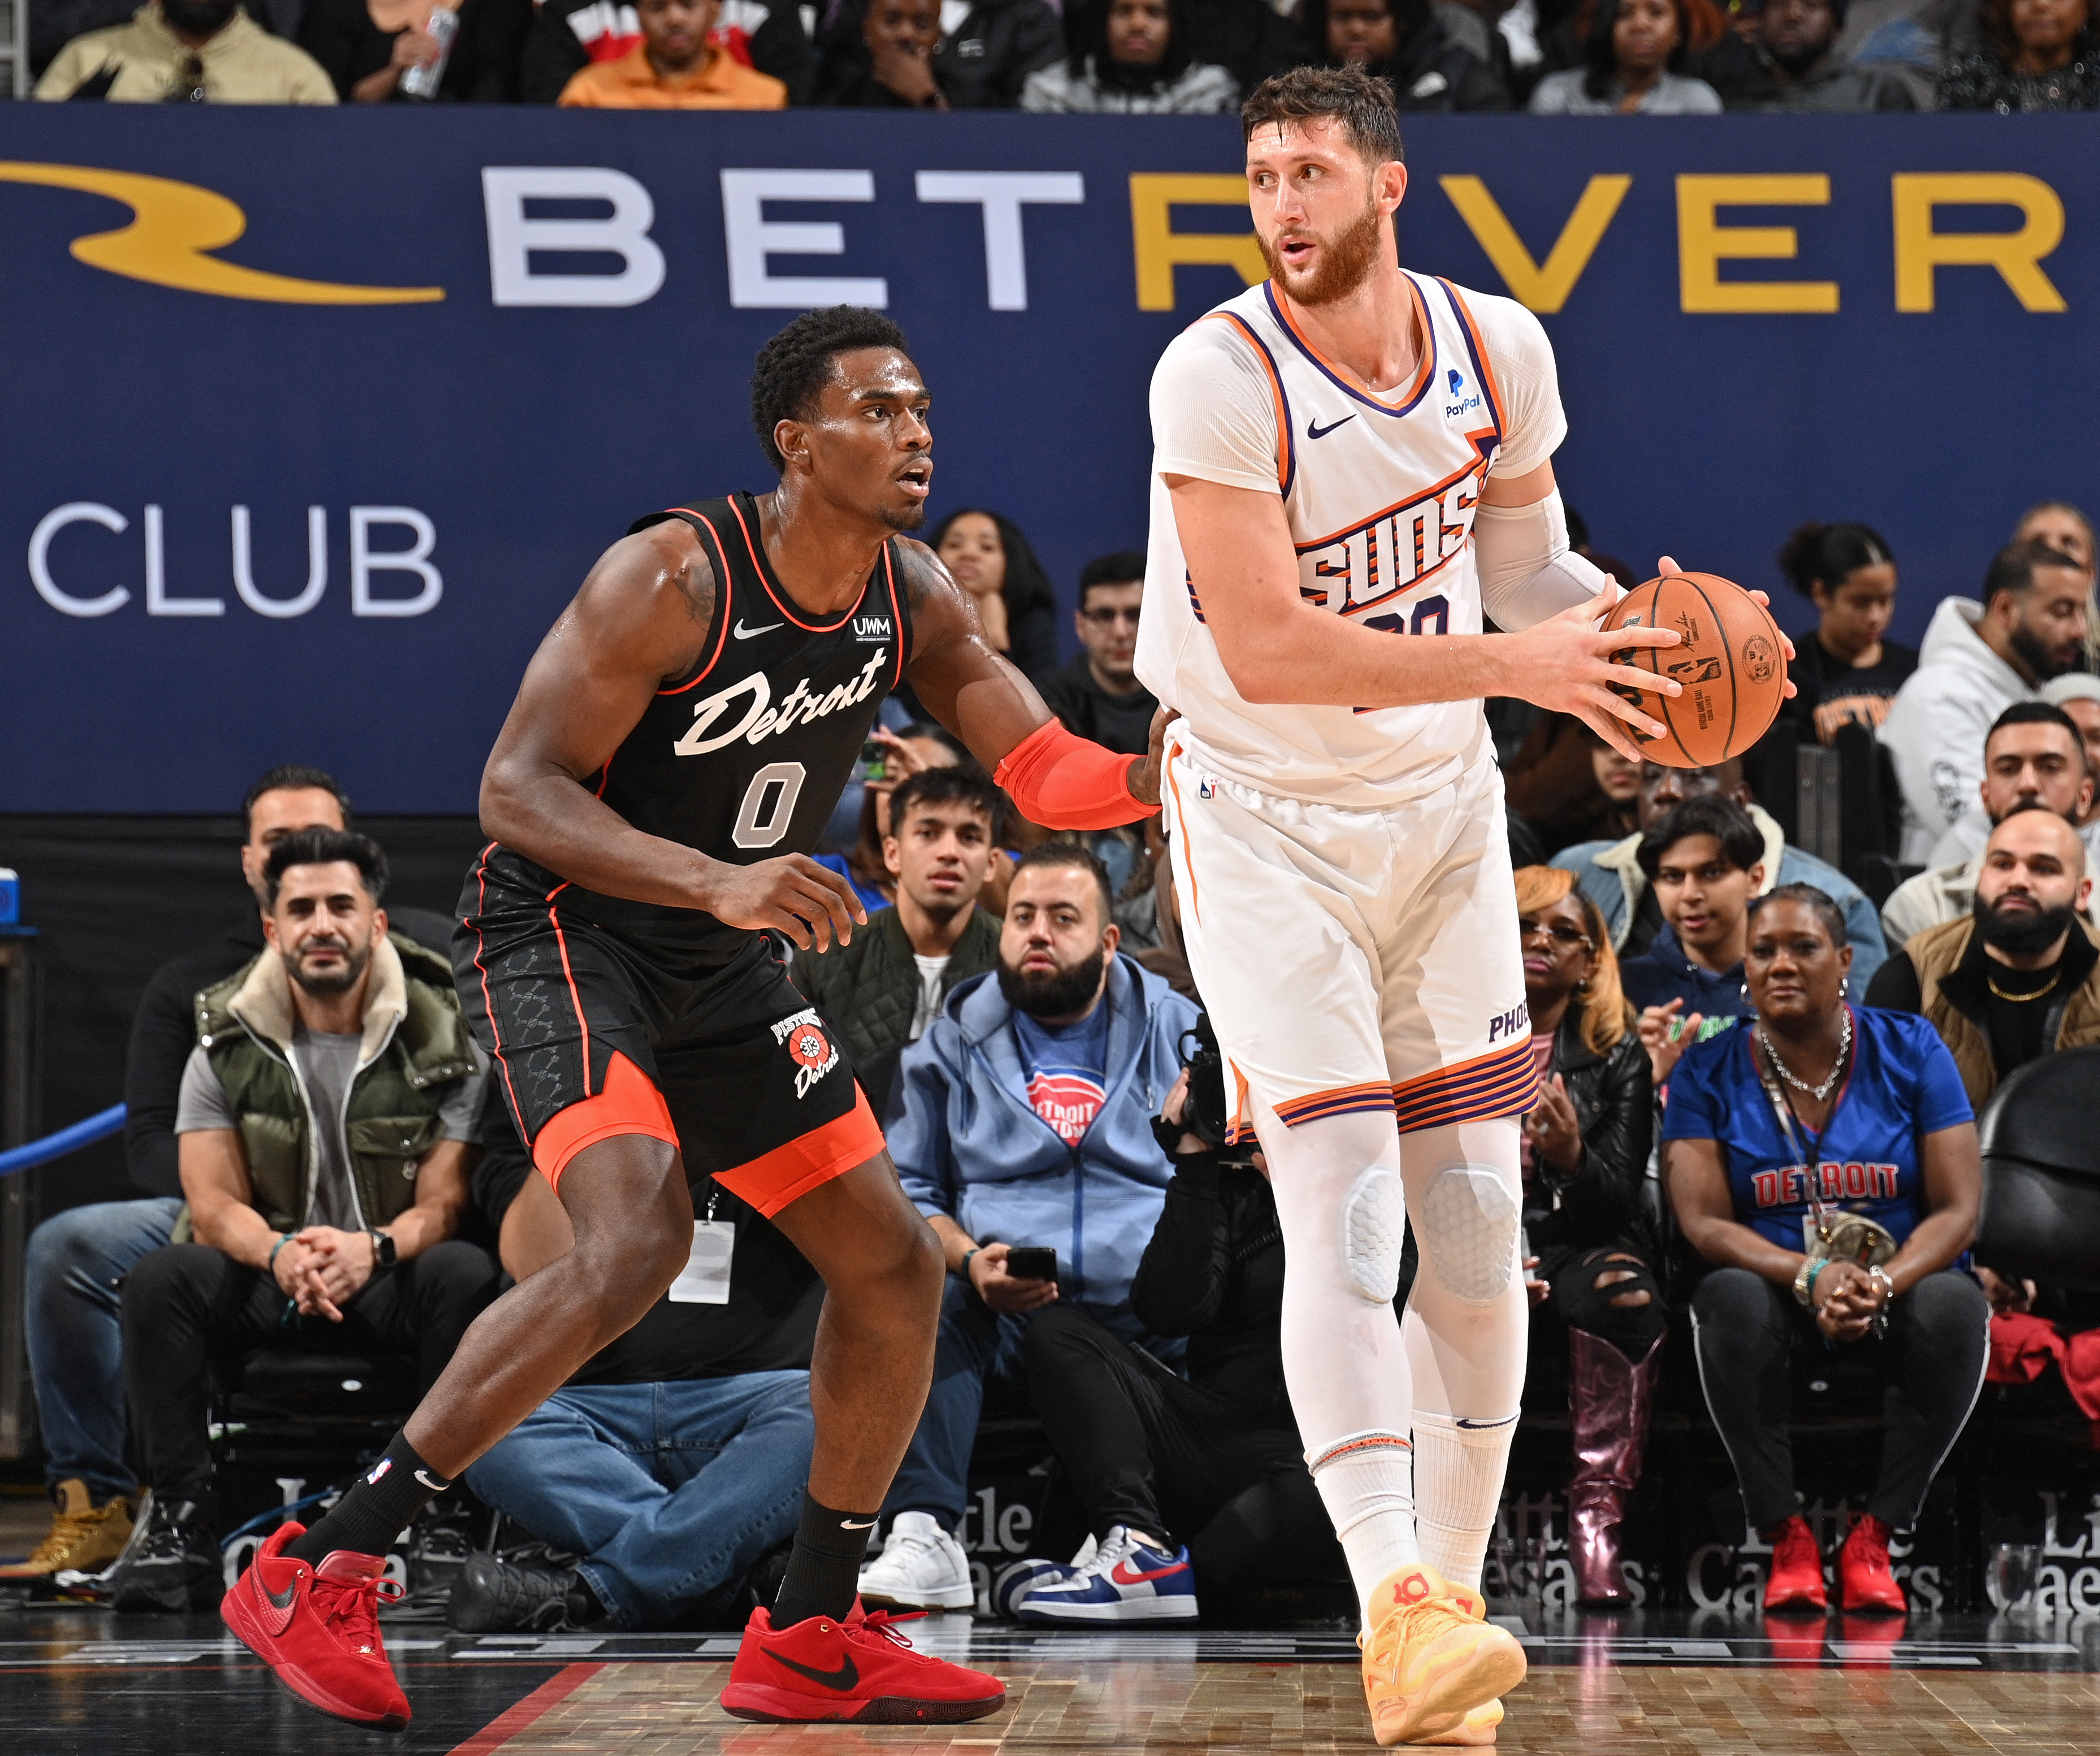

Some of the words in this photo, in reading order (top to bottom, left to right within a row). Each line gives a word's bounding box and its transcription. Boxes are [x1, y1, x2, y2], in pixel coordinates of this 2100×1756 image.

[1446, 393, 1480, 418] PayPal
[28, 501, 444, 618] CLUB
[852, 618, 891, 635] UWM
[674, 647, 886, 756] Detroit
[1693, 689, 1703, 700] BALL
[732, 762, 806, 848] 0
[770, 1008, 822, 1046] PISTONS
[795, 1044, 839, 1099] Detroit
[1036, 1100, 1095, 1124] ETROIT
